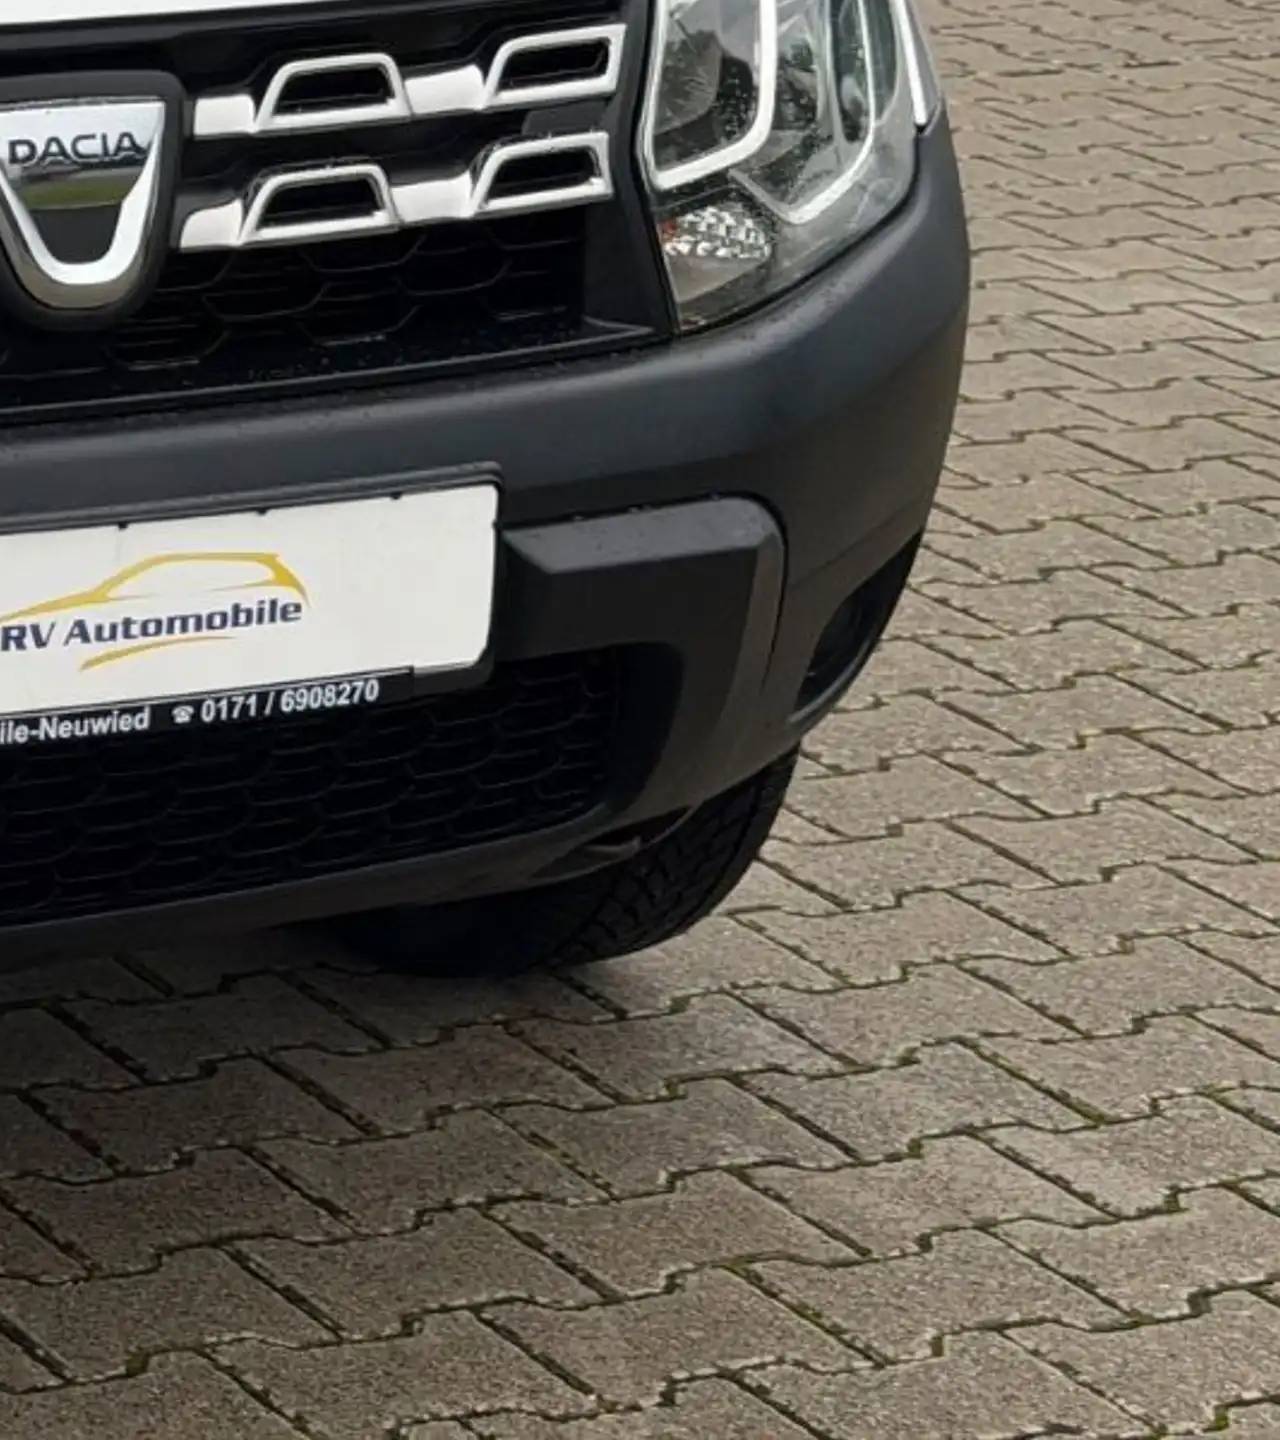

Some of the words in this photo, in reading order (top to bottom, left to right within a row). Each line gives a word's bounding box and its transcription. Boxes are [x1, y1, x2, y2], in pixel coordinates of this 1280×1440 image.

[7, 131, 148, 166] DACIA
[0, 621, 57, 652] RV
[63, 597, 303, 646] Automobile
[200, 694, 258, 723] 0171
[280, 678, 380, 715] 6908270
